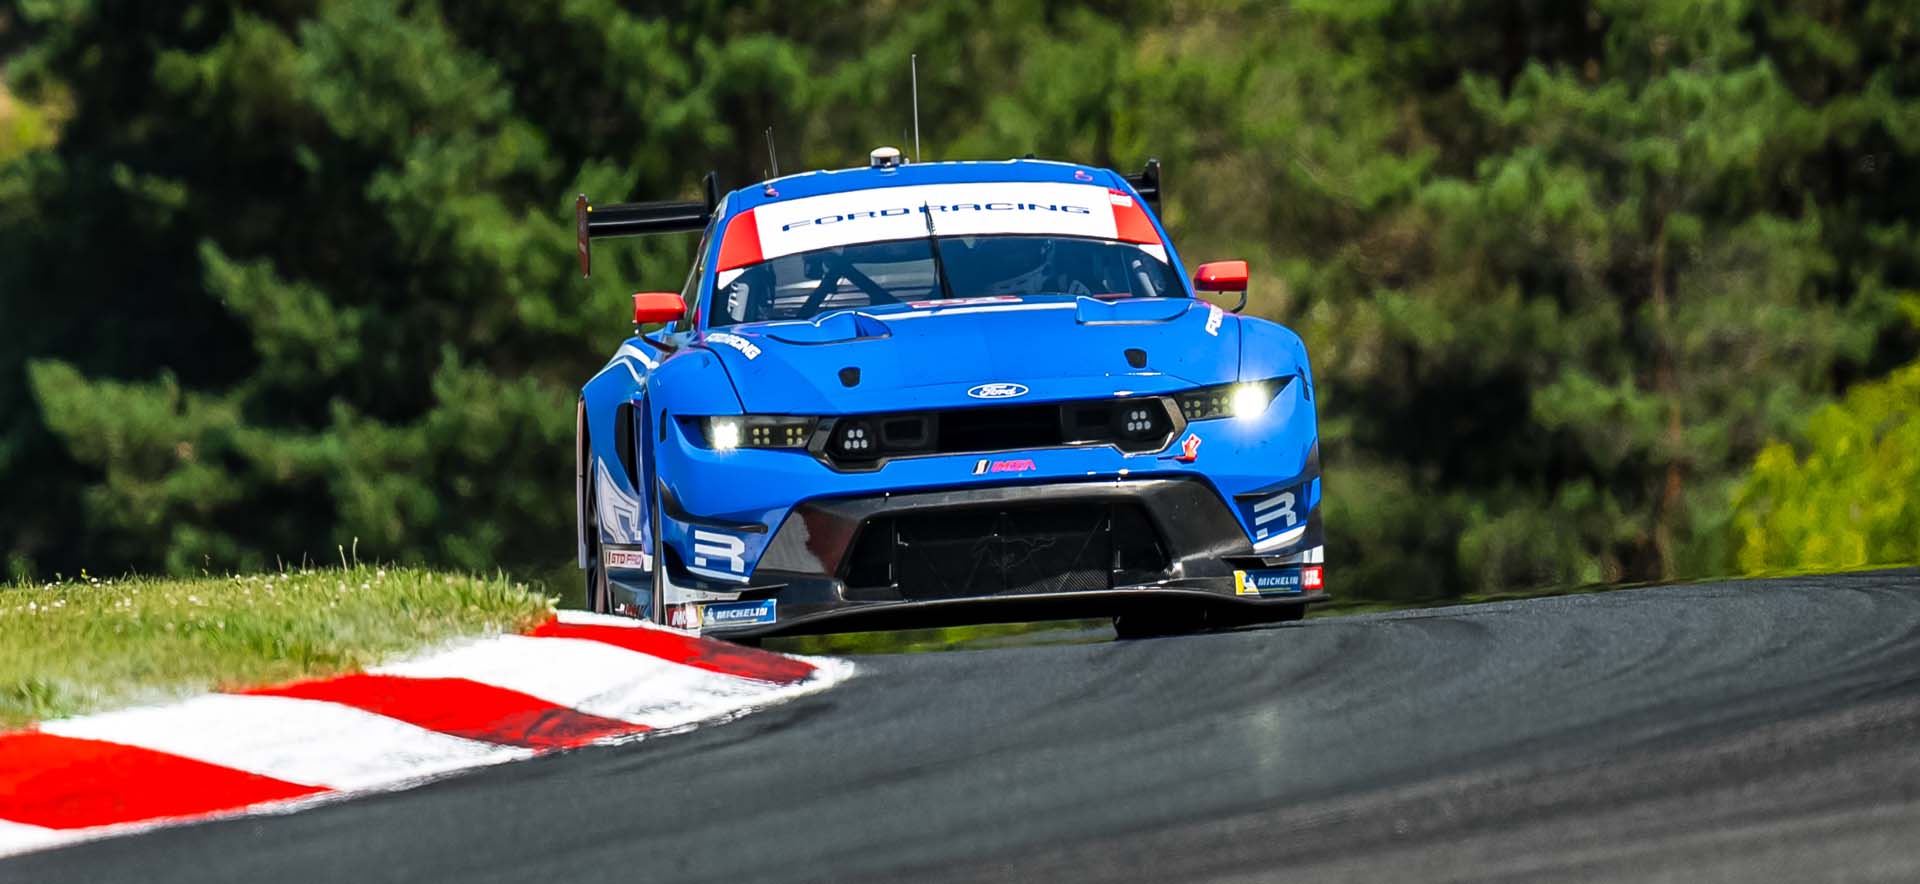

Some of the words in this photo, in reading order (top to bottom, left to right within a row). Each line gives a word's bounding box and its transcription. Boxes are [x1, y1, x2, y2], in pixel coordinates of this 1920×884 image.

[782, 208, 910, 232] FORD
[918, 202, 1091, 215] RACING
[979, 384, 1017, 397] Ford
[1257, 576, 1299, 587] MICHELIN
[716, 607, 768, 620] MICHELIN
